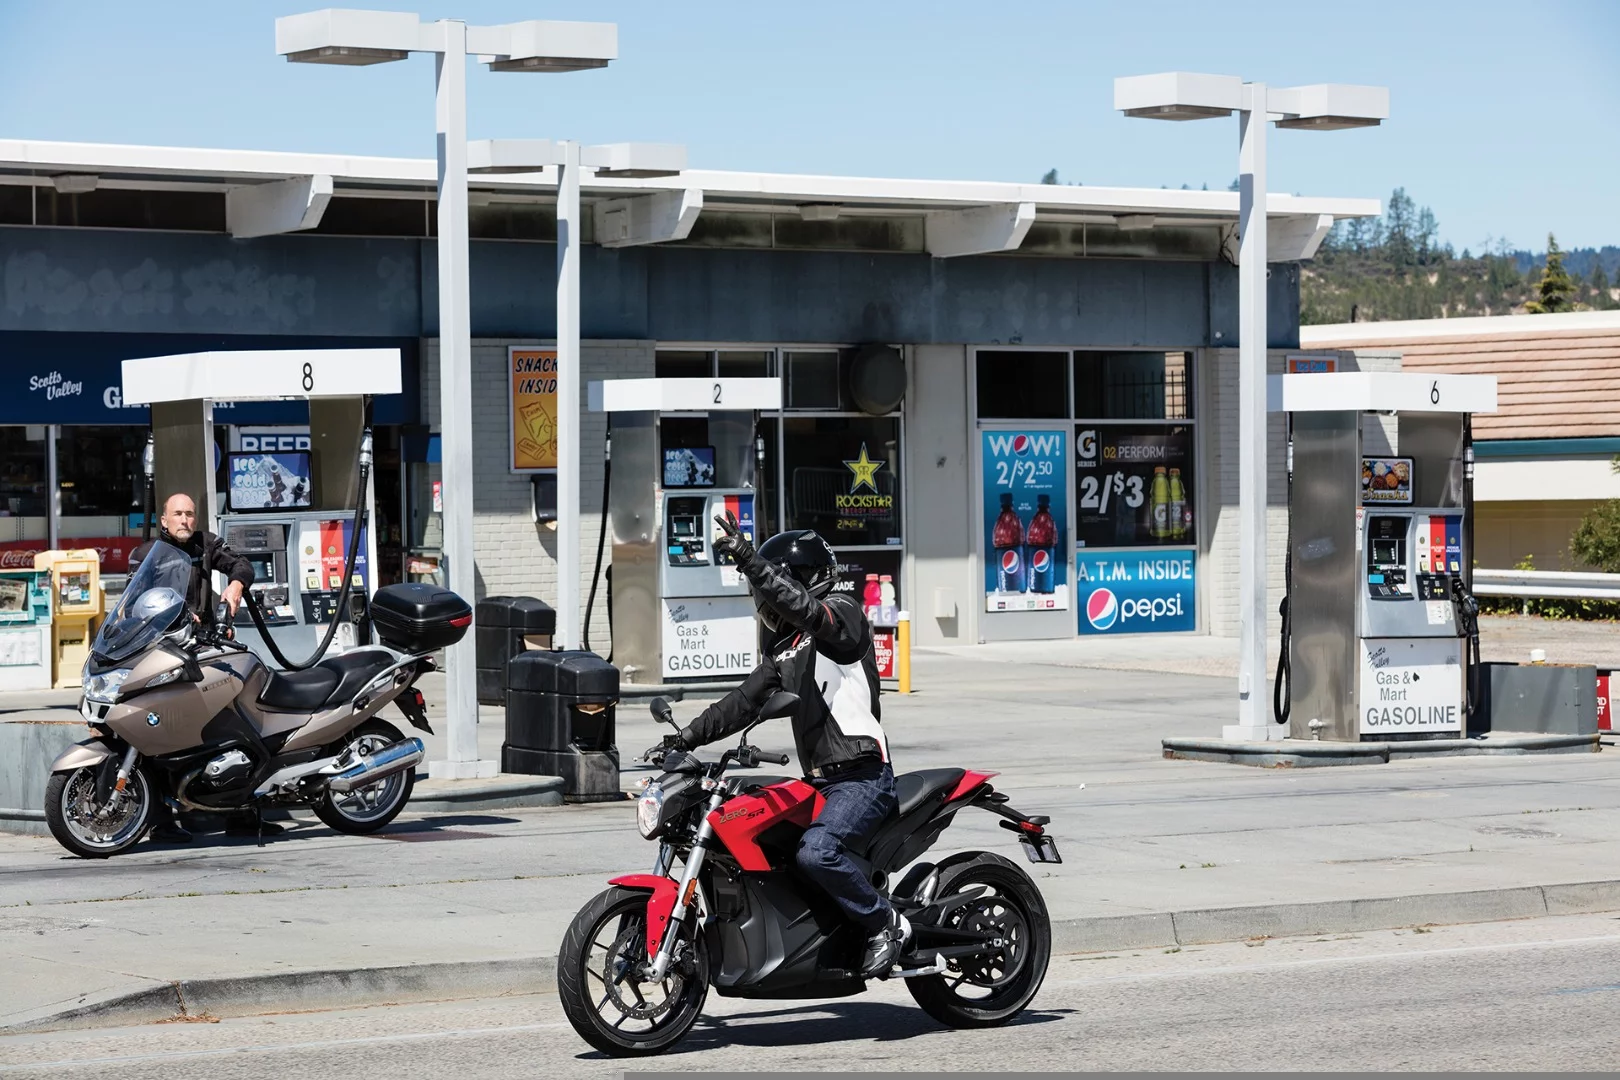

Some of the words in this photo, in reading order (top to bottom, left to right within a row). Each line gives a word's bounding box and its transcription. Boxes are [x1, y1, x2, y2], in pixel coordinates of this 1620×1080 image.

[29, 371, 62, 391] Scotts
[302, 362, 314, 392] 8
[519, 379, 557, 393] INSID
[46, 381, 82, 400] Valley
[713, 383, 722, 404] 2
[1430, 380, 1440, 404] 6
[988, 434, 1060, 457] WOW!
[1077, 429, 1096, 459] G
[1118, 445, 1165, 459] PERFORM
[1077, 560, 1132, 582] A.T.M.
[1138, 559, 1192, 580] INSIDE
[1121, 592, 1183, 623] pepsi
[676, 625, 699, 637] Gas
[701, 624, 709, 636] &
[680, 638, 706, 650] Mart
[668, 652, 752, 671] GASOLINE
[1376, 671, 1400, 685] Gas
[1402, 670, 1411, 685] &
[1380, 687, 1407, 701] Mart
[1366, 705, 1456, 726] GASOLINE
[719, 807, 748, 824] ZERO
[745, 807, 766, 820] SR
